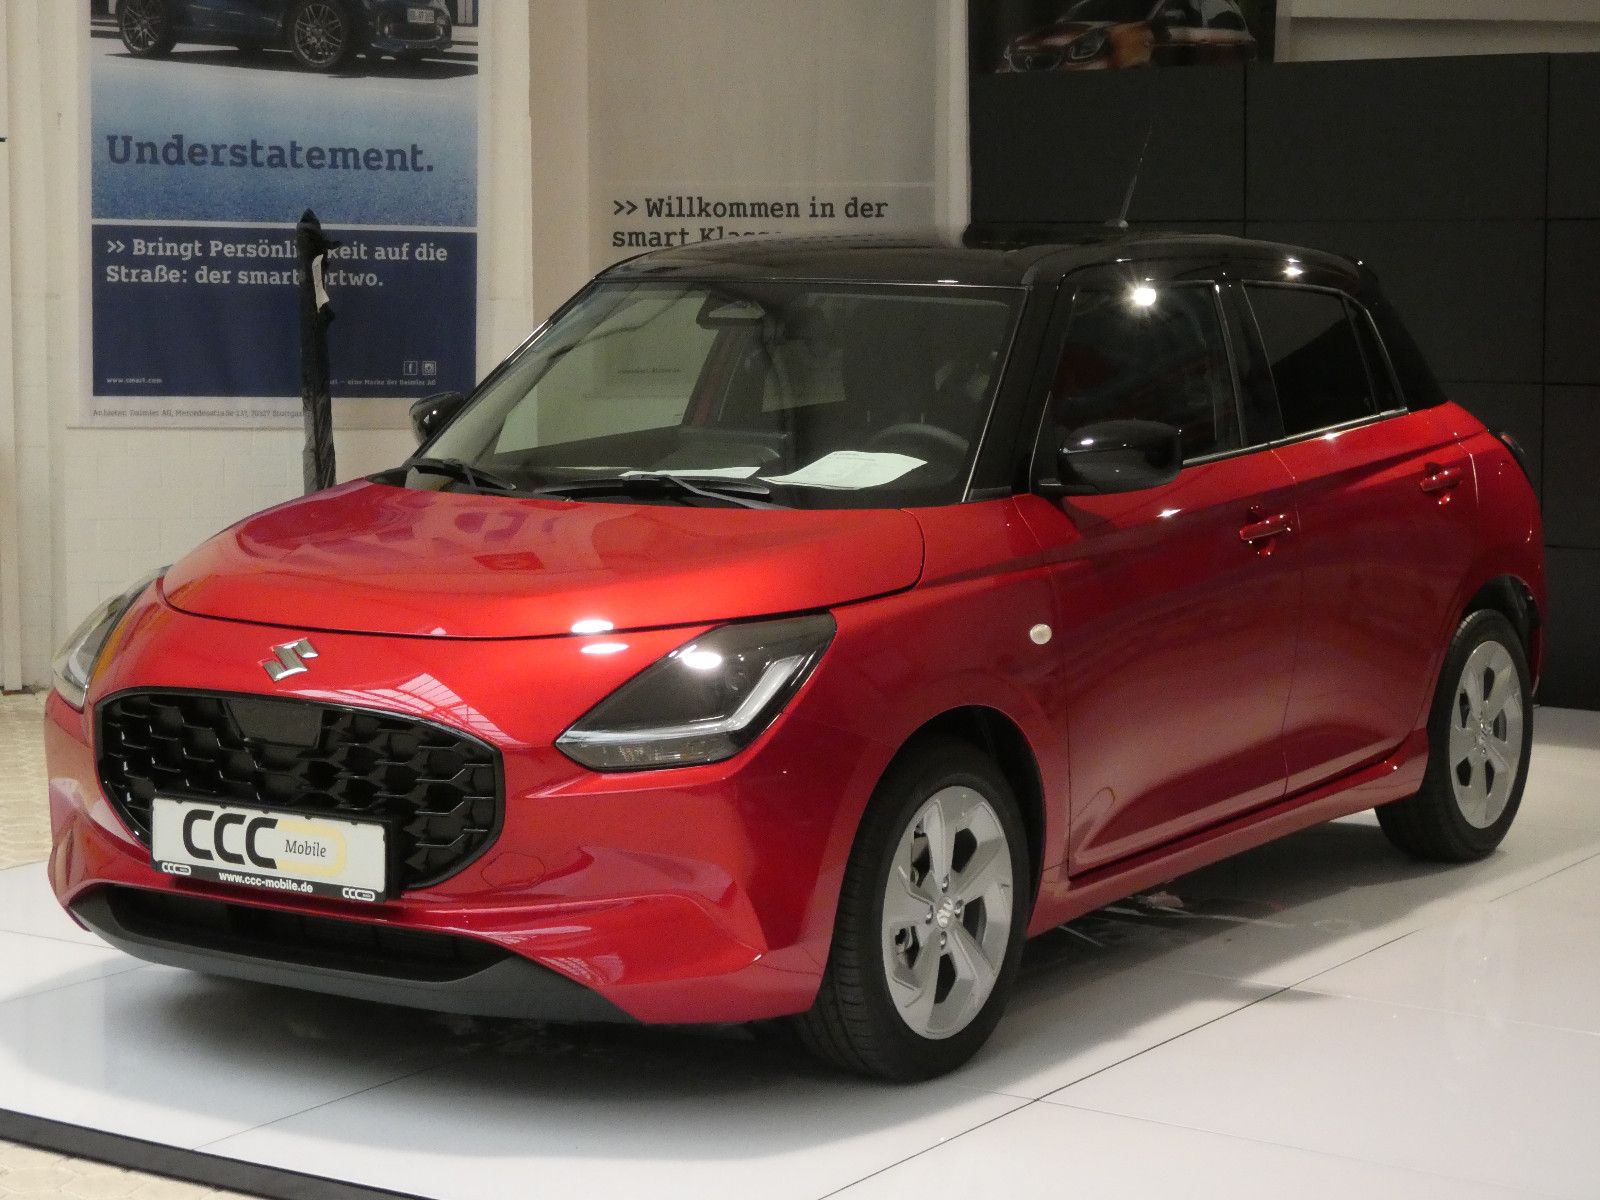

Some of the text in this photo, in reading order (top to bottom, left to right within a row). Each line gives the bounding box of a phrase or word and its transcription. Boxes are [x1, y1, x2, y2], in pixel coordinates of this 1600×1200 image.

[106, 134, 433, 172] Understatement.
[645, 196, 801, 218] Willkommen
[809, 196, 836, 218] in
[845, 196, 889, 218] der
[133, 237, 203, 261] Bringt
[209, 239, 367, 261] Persönlikeit
[375, 243, 410, 261] auf
[415, 243, 448, 261] die
[612, 227, 690, 248] smart
[106, 264, 384, 287] Straße: der smart rtwo.
[183, 809, 327, 869] CCC Mobile
[219, 871, 313, 893] www.ccc-mobile.de
